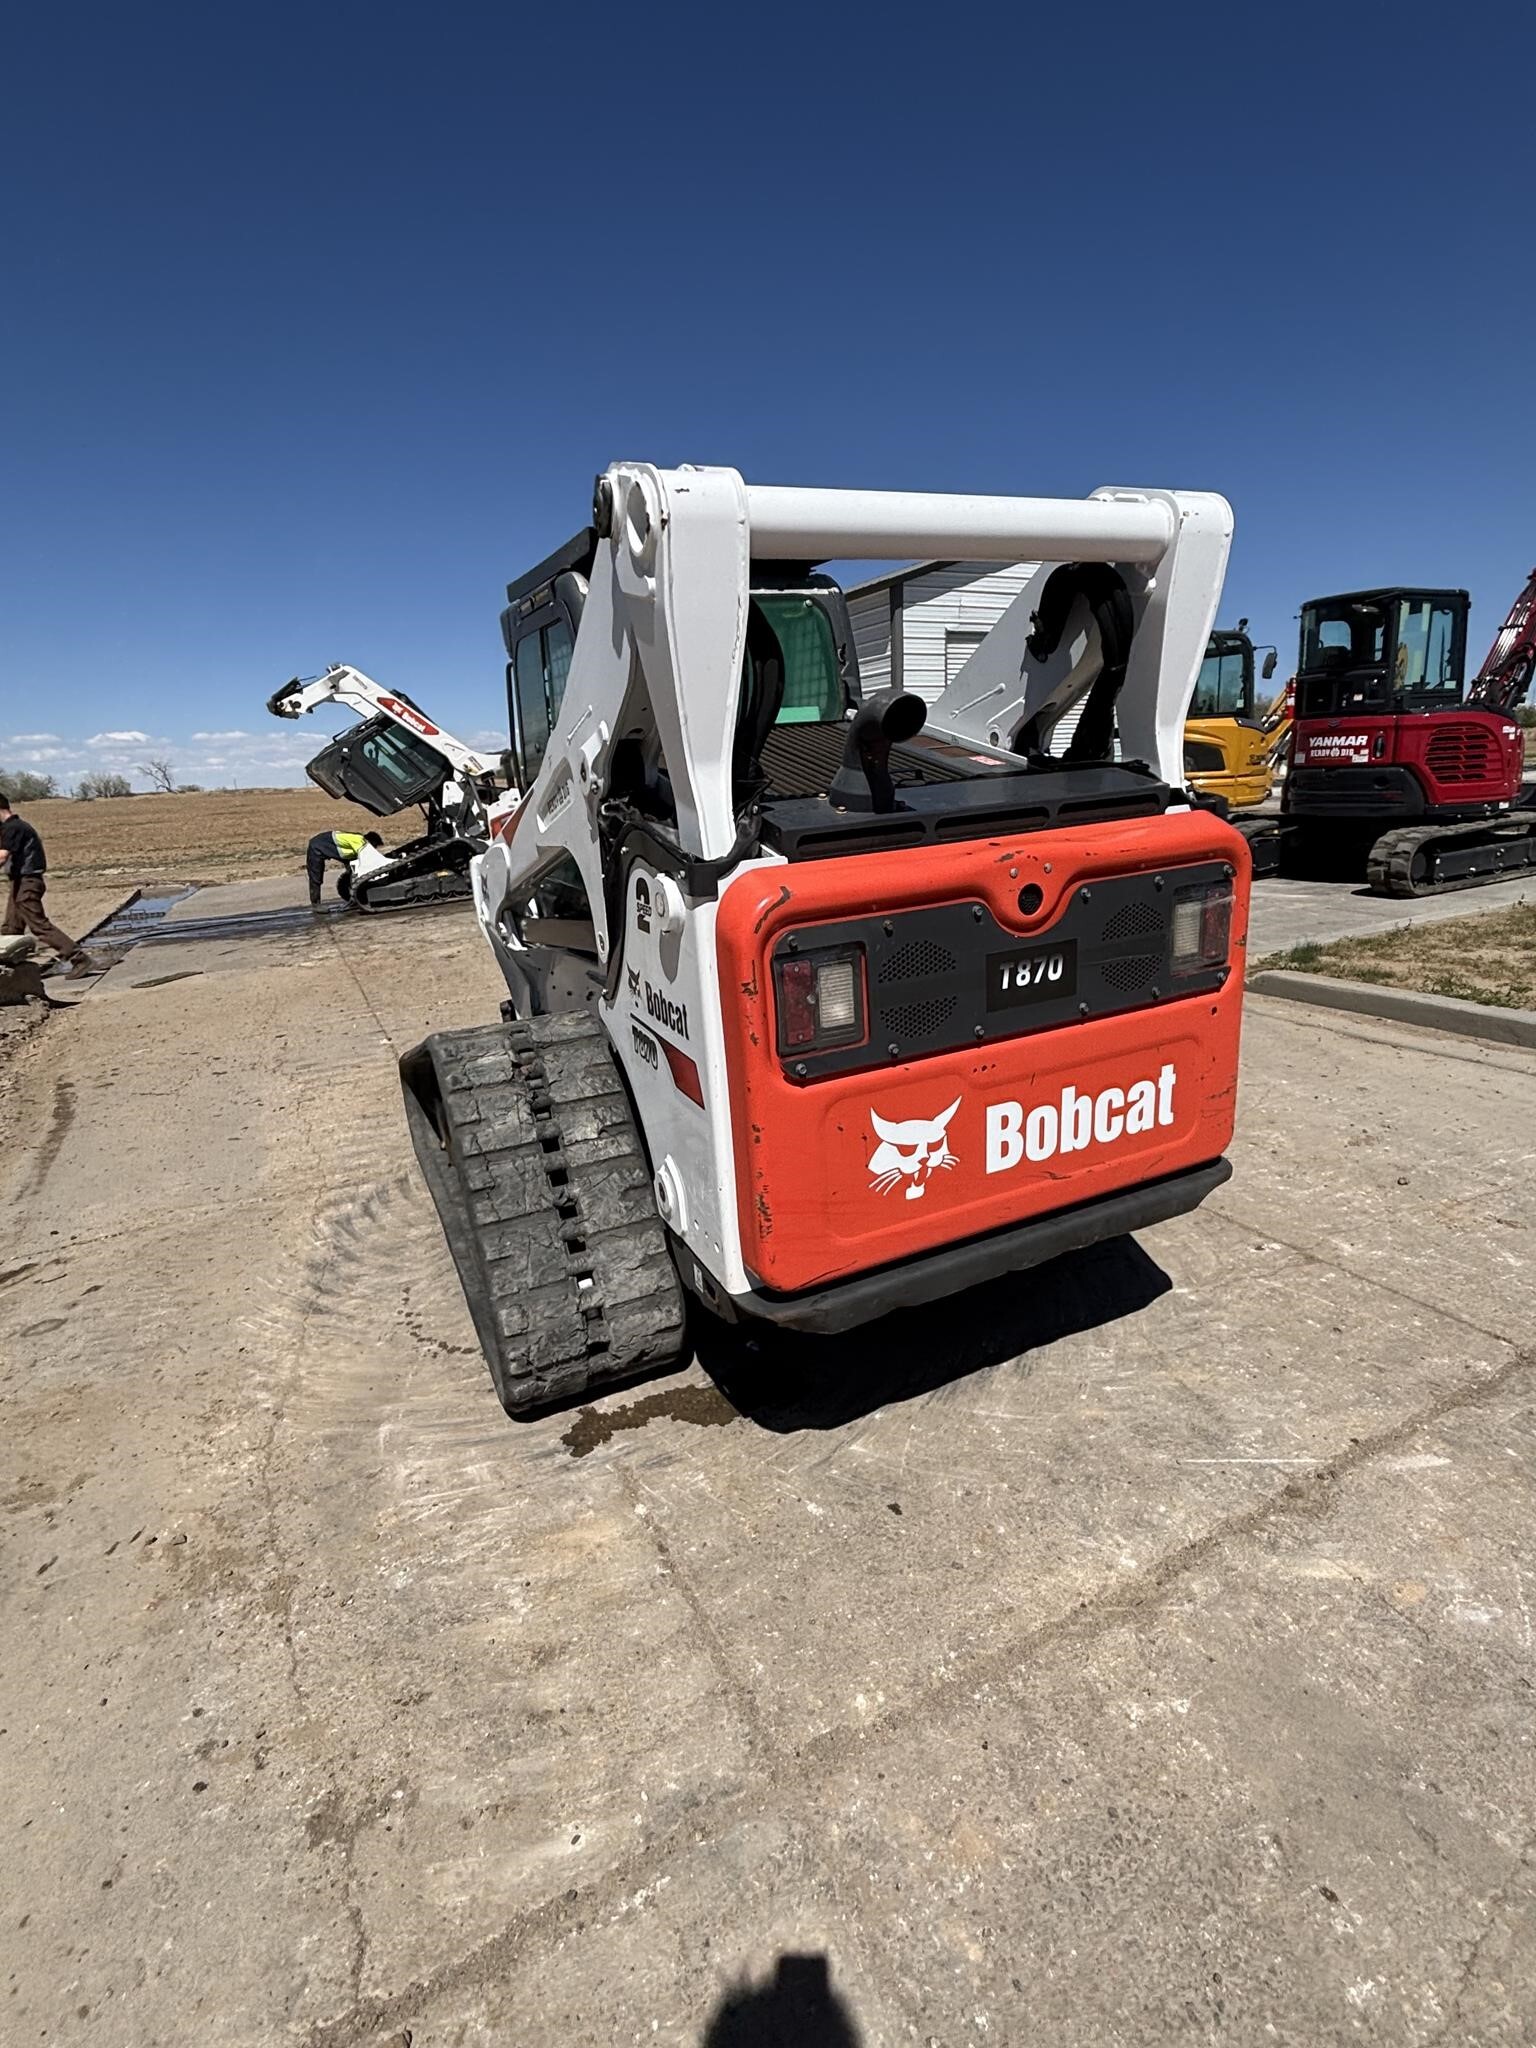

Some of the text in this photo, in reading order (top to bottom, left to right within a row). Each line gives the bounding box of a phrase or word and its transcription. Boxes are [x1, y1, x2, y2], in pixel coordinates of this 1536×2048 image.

[1309, 735, 1369, 747] YANMAR
[636, 902, 652, 917] SPEED
[1000, 953, 1064, 990] T870
[645, 980, 690, 1041] Bobcat
[986, 1063, 1177, 1175] Bobcat
